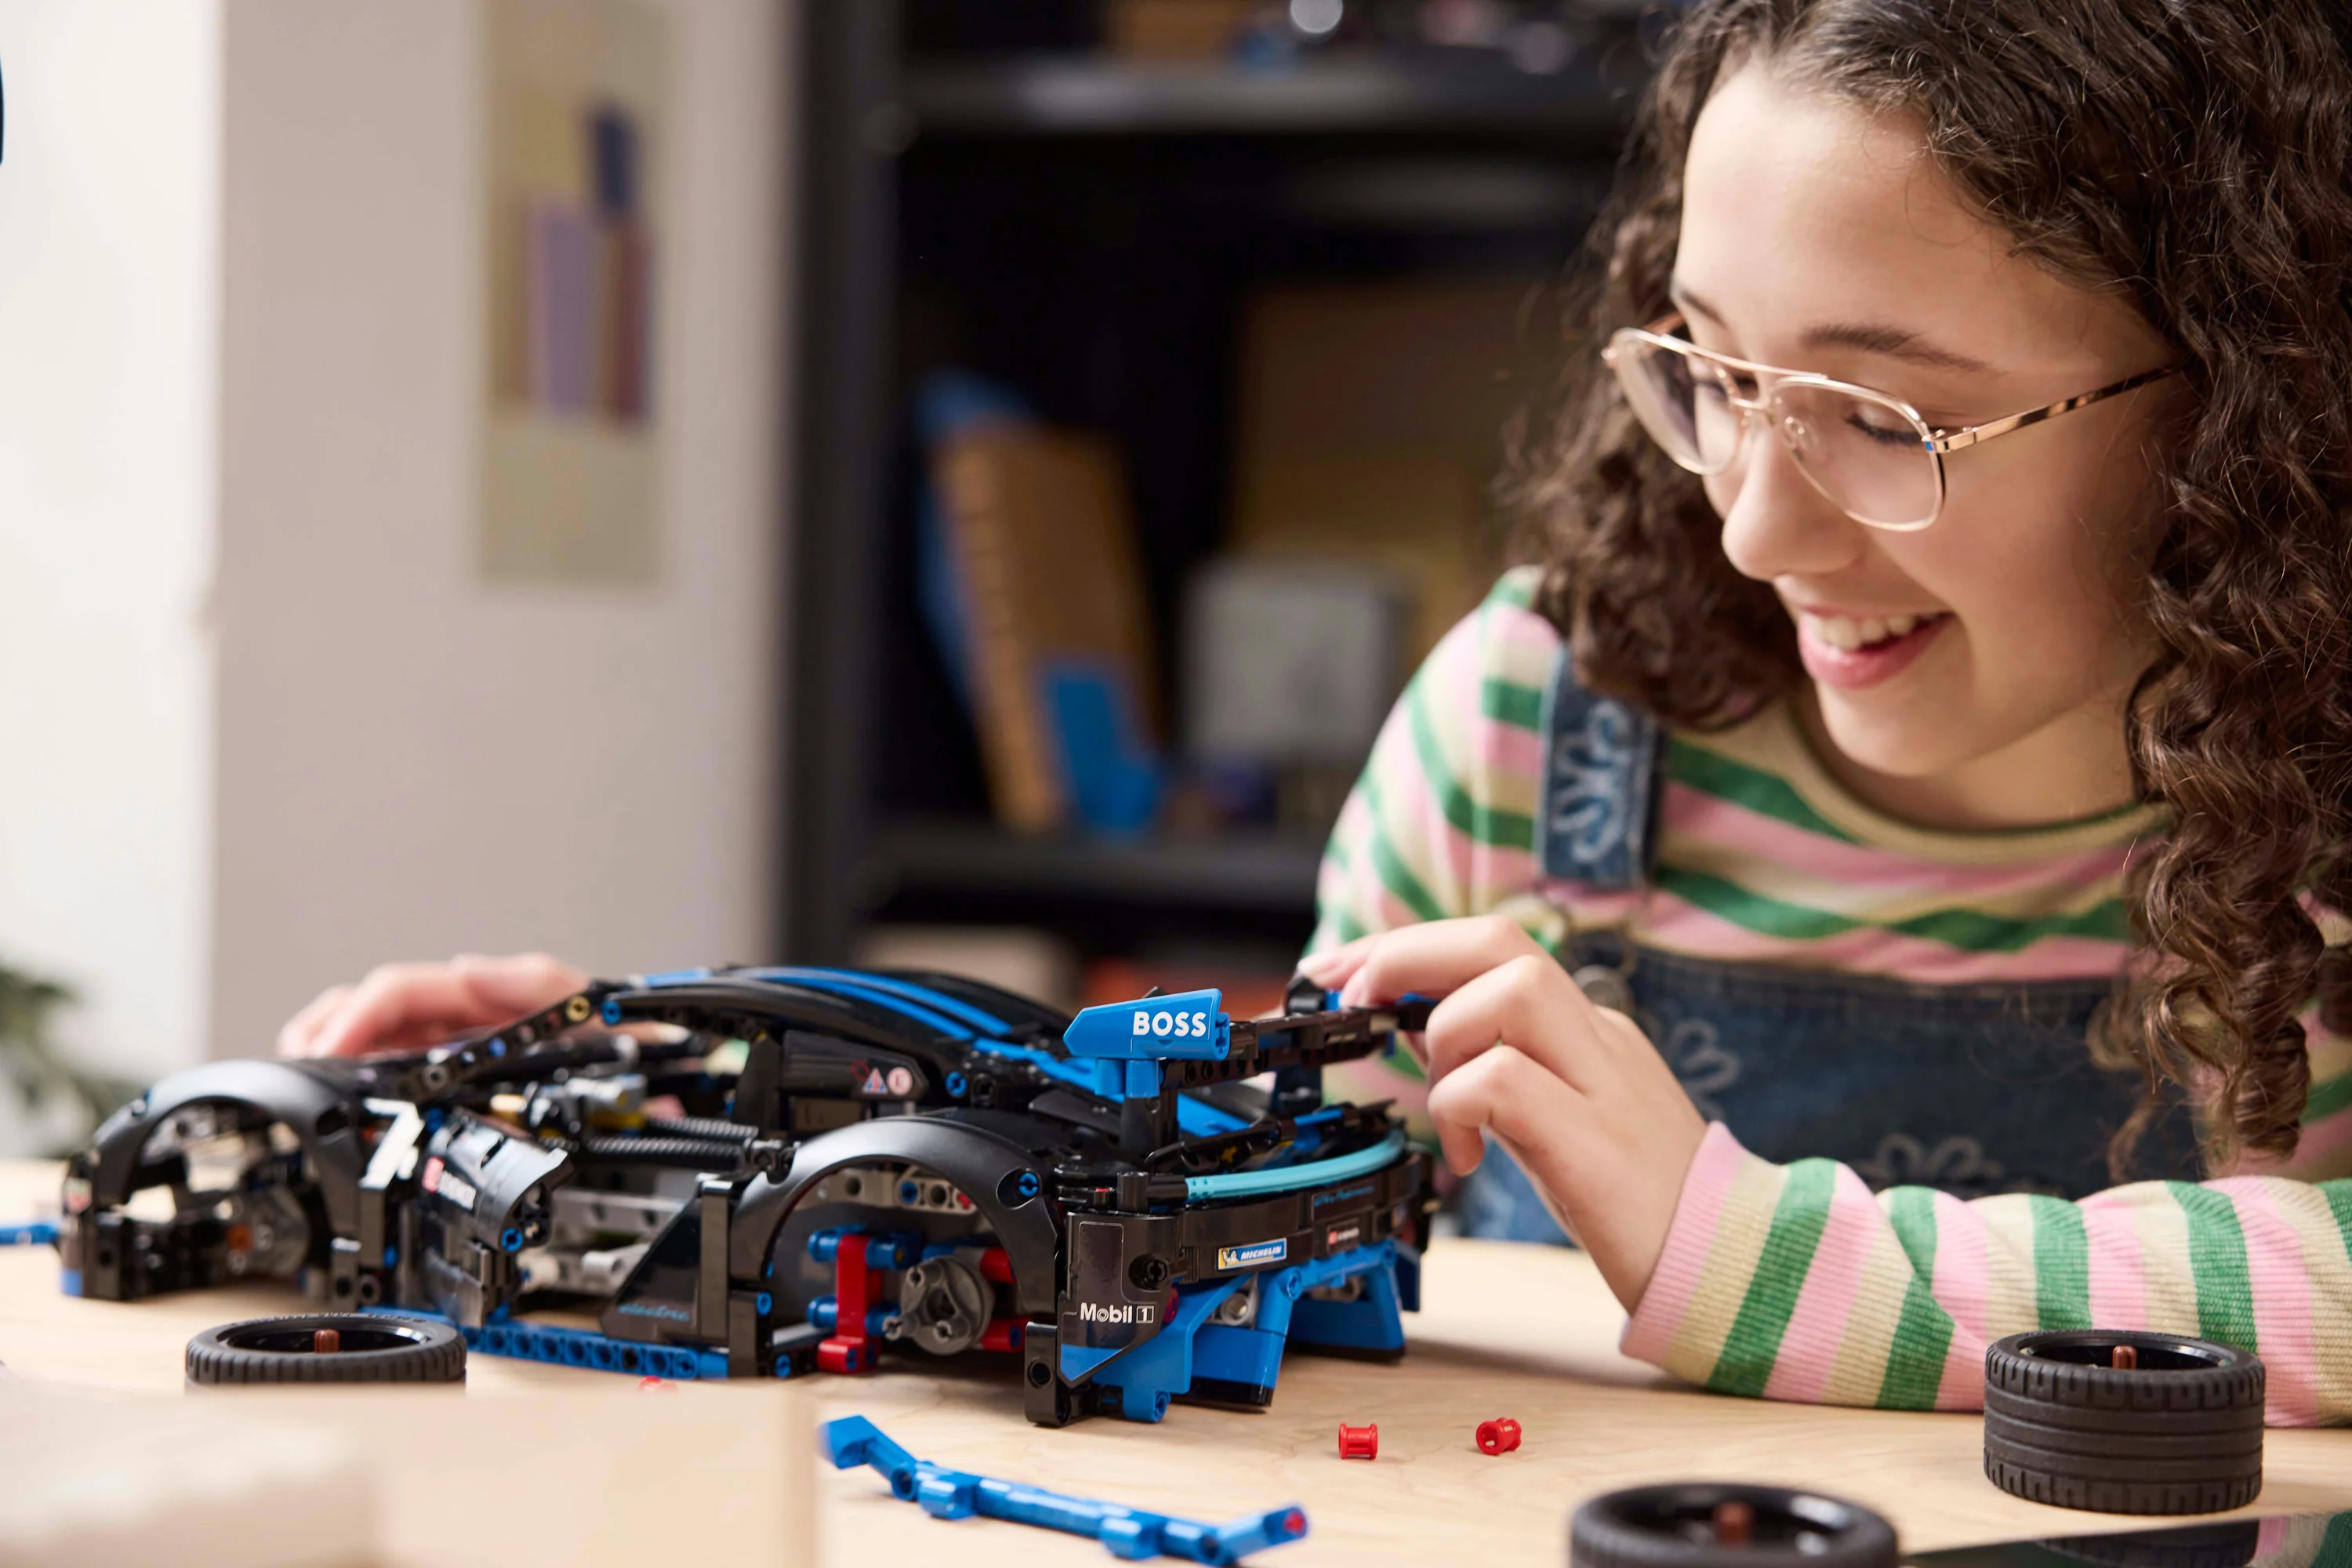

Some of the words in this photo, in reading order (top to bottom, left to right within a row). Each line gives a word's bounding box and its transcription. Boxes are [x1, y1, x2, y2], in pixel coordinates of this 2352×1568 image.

[1133, 1011, 1207, 1037] BOSS
[1240, 1245, 1283, 1261] MICHELIN
[1080, 1302, 1133, 1323] Mobil
